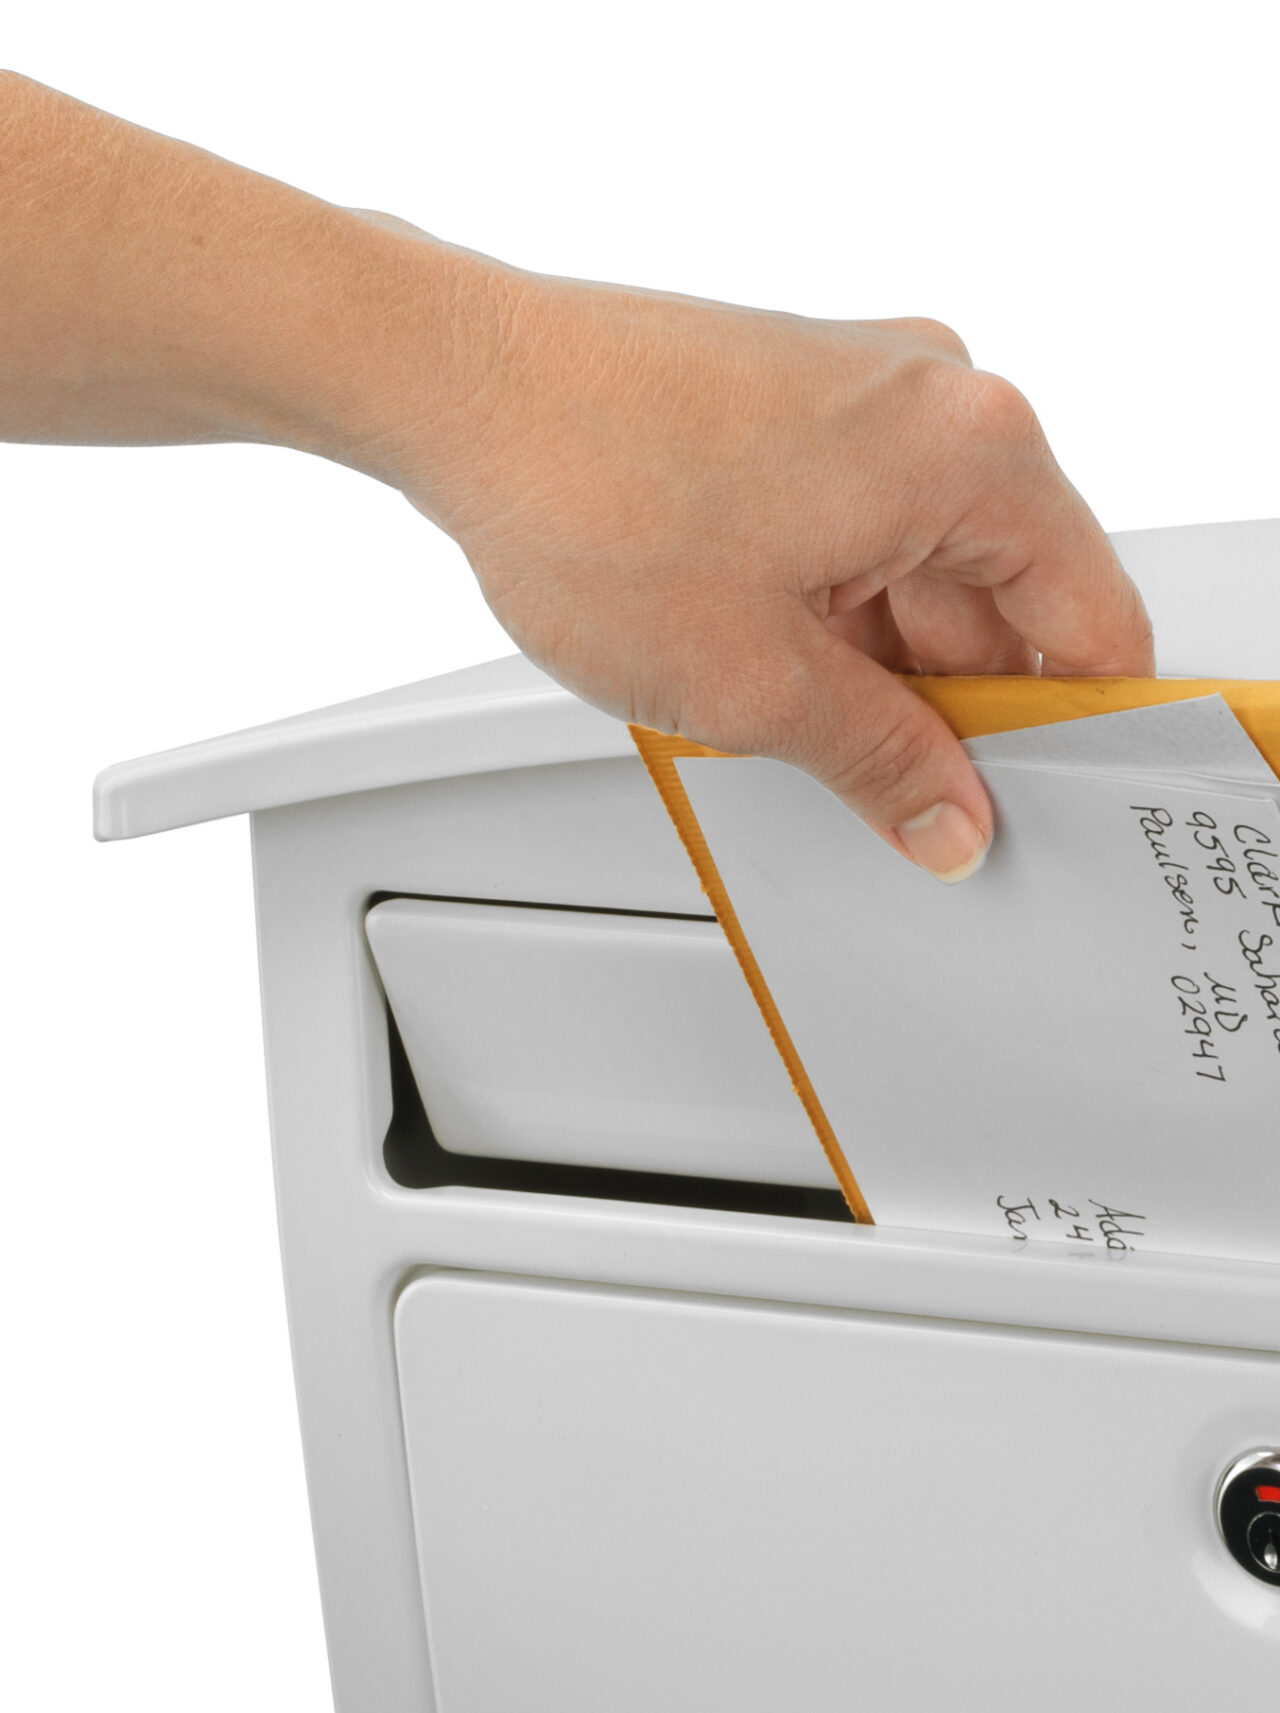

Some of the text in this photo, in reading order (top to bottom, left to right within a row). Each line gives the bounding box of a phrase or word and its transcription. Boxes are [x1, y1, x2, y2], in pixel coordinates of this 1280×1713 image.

[1186, 811, 1247, 899] 9595
[1130, 805, 1248, 1032] Paulsen, MD
[1171, 974, 1227, 1083] 02947
